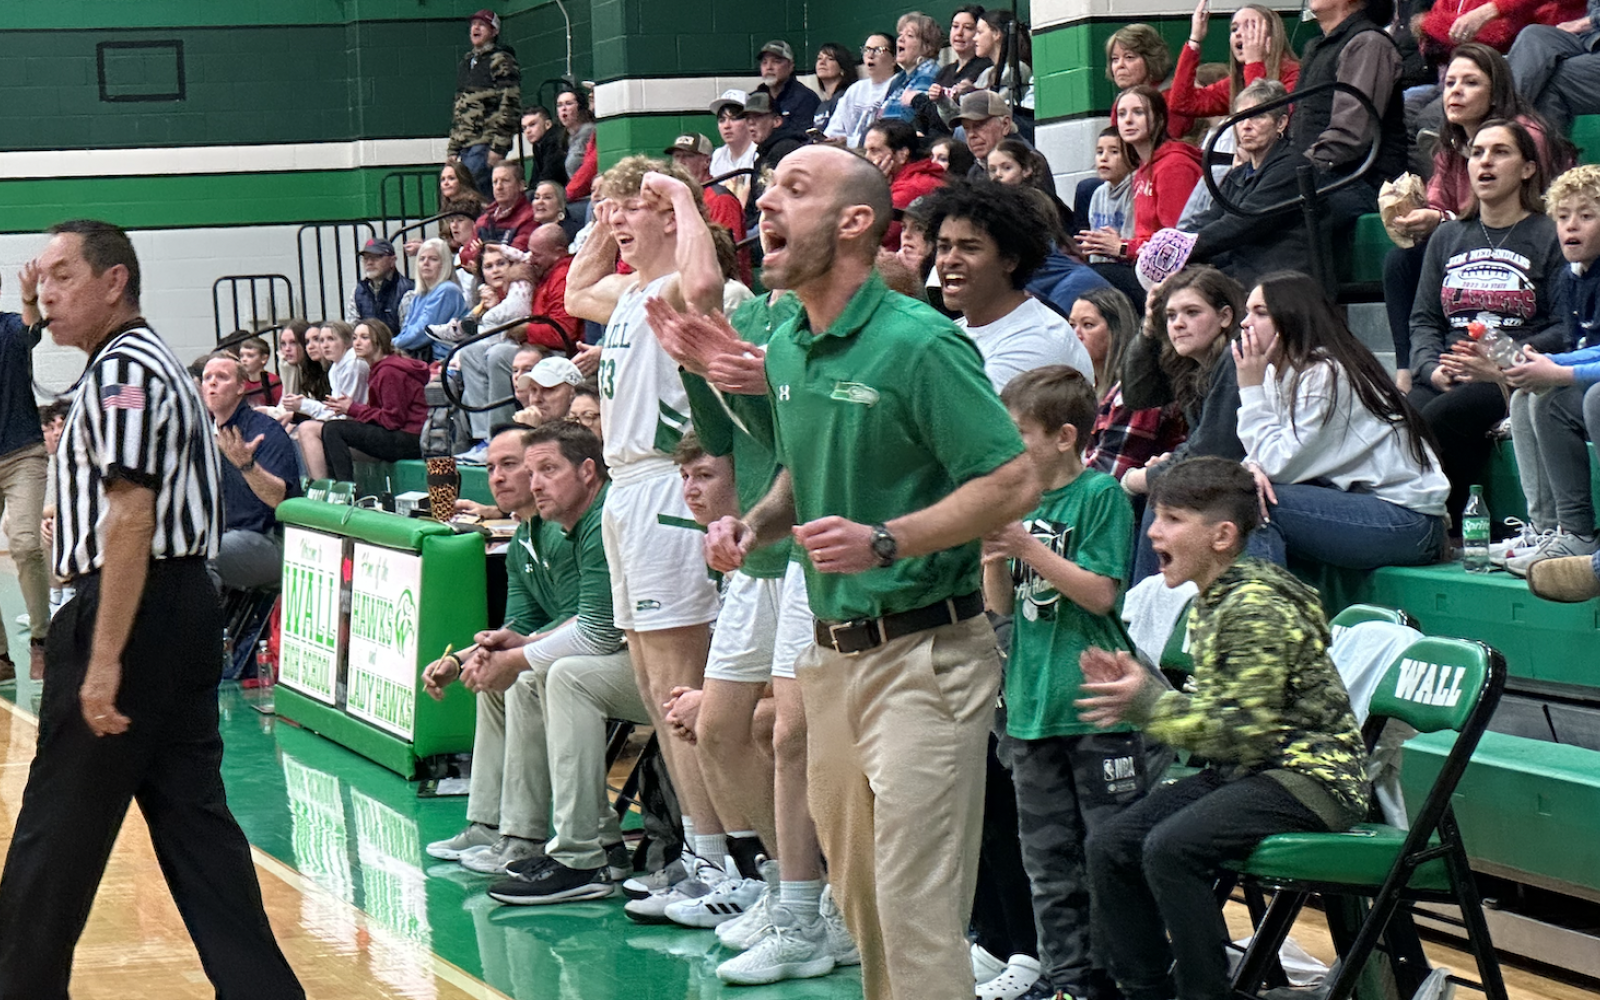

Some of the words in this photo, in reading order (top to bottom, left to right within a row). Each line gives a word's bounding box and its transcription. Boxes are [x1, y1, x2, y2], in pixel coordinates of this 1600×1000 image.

[283, 560, 335, 653] WALL
[352, 590, 394, 650] HAWKS
[348, 664, 375, 717] LADY
[373, 673, 413, 733] HAWKS
[1394, 657, 1466, 707] WALL
[1115, 756, 1136, 779] NBA
